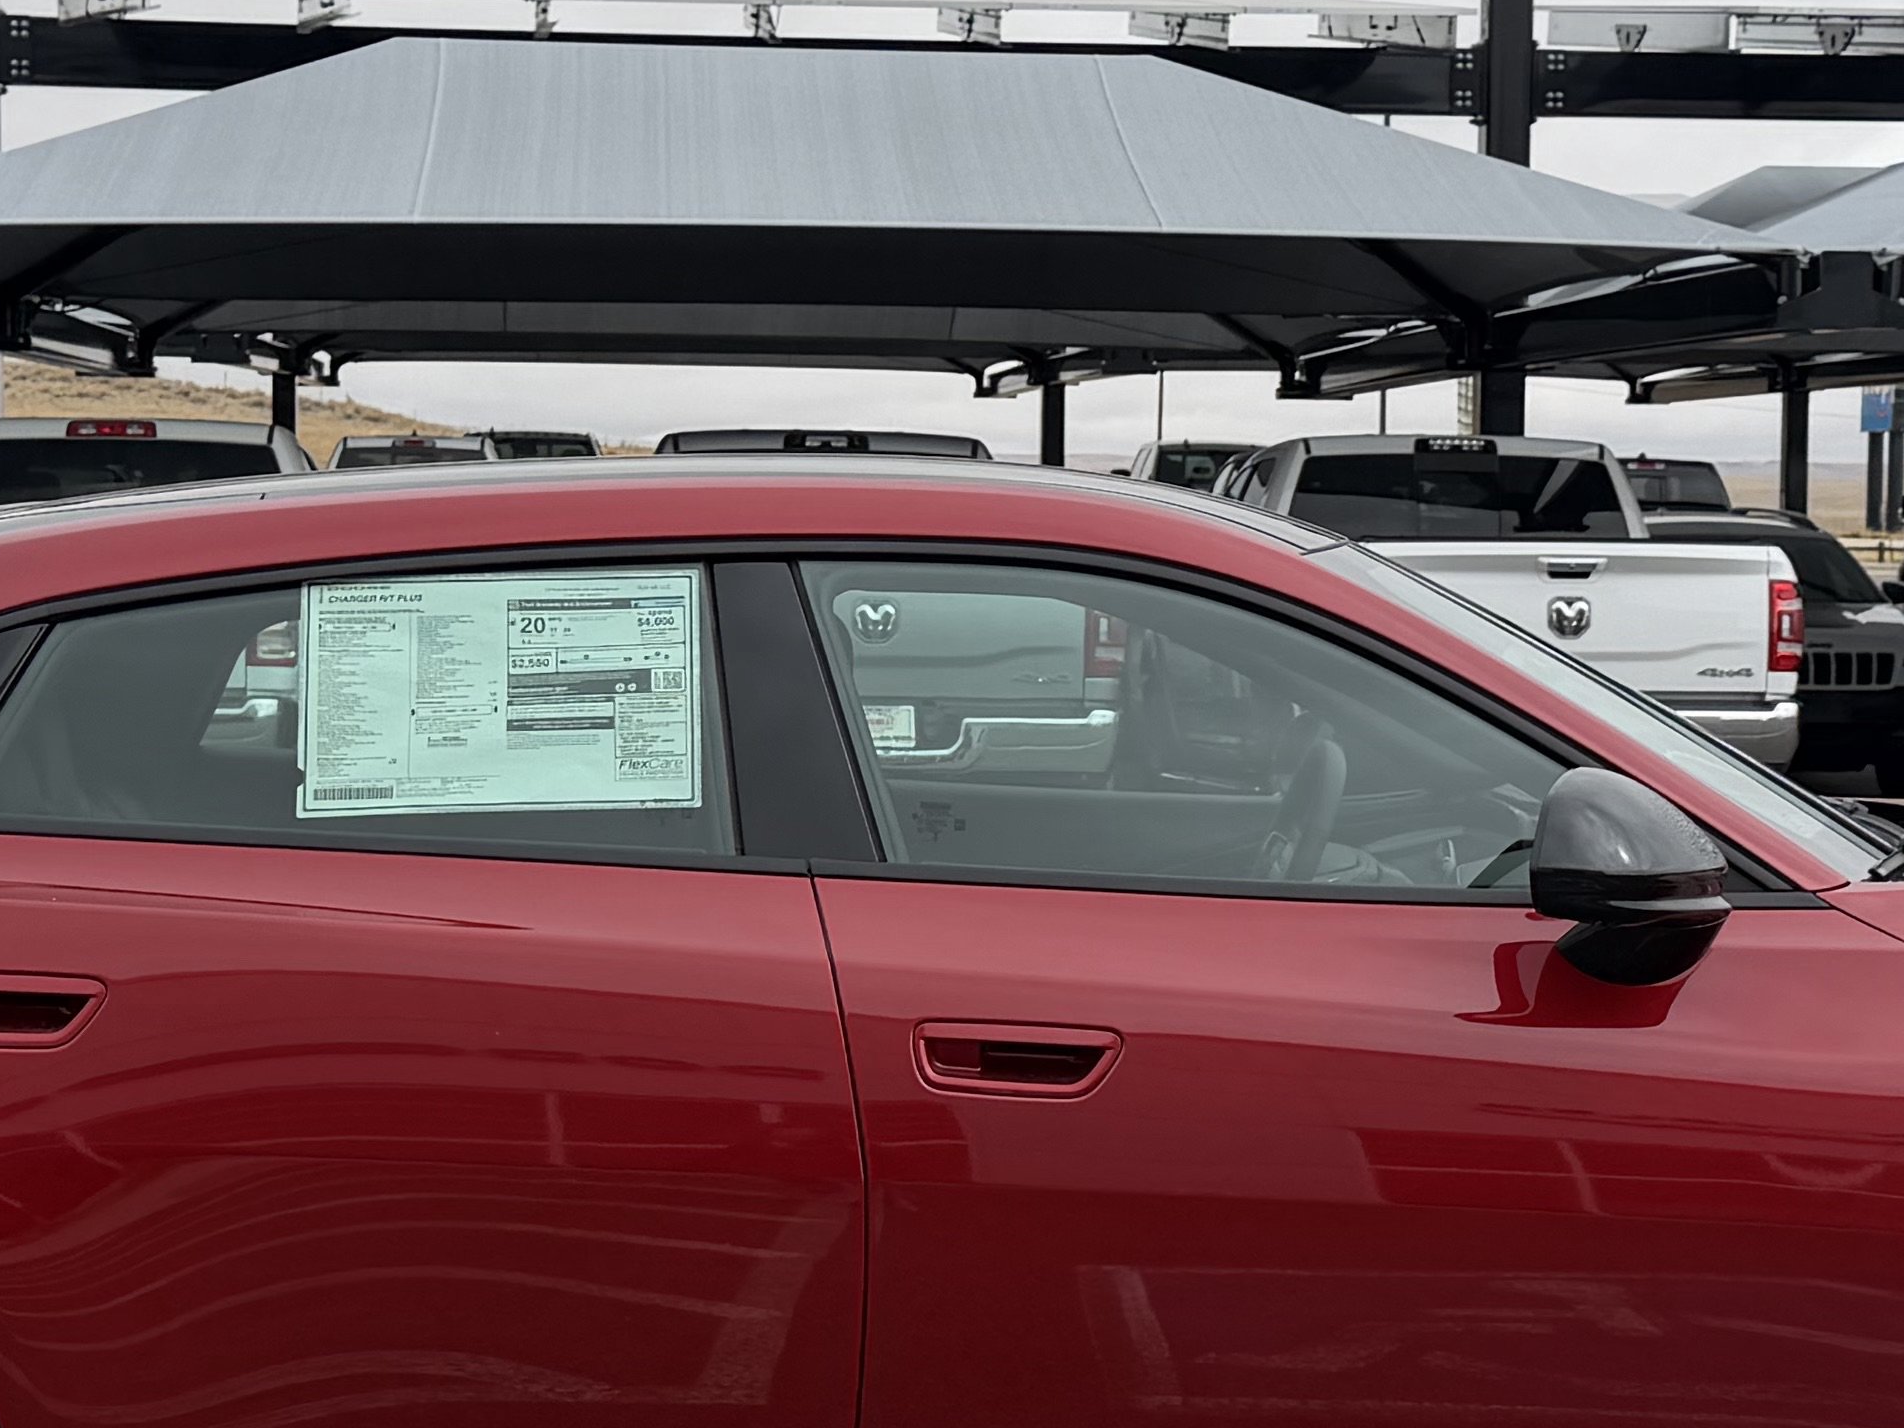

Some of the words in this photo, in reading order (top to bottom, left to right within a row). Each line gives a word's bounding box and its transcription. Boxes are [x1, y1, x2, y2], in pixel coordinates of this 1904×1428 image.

[397, 594, 423, 603] PLUS
[520, 616, 546, 634] 20
[619, 758, 684, 770] FlexCare
